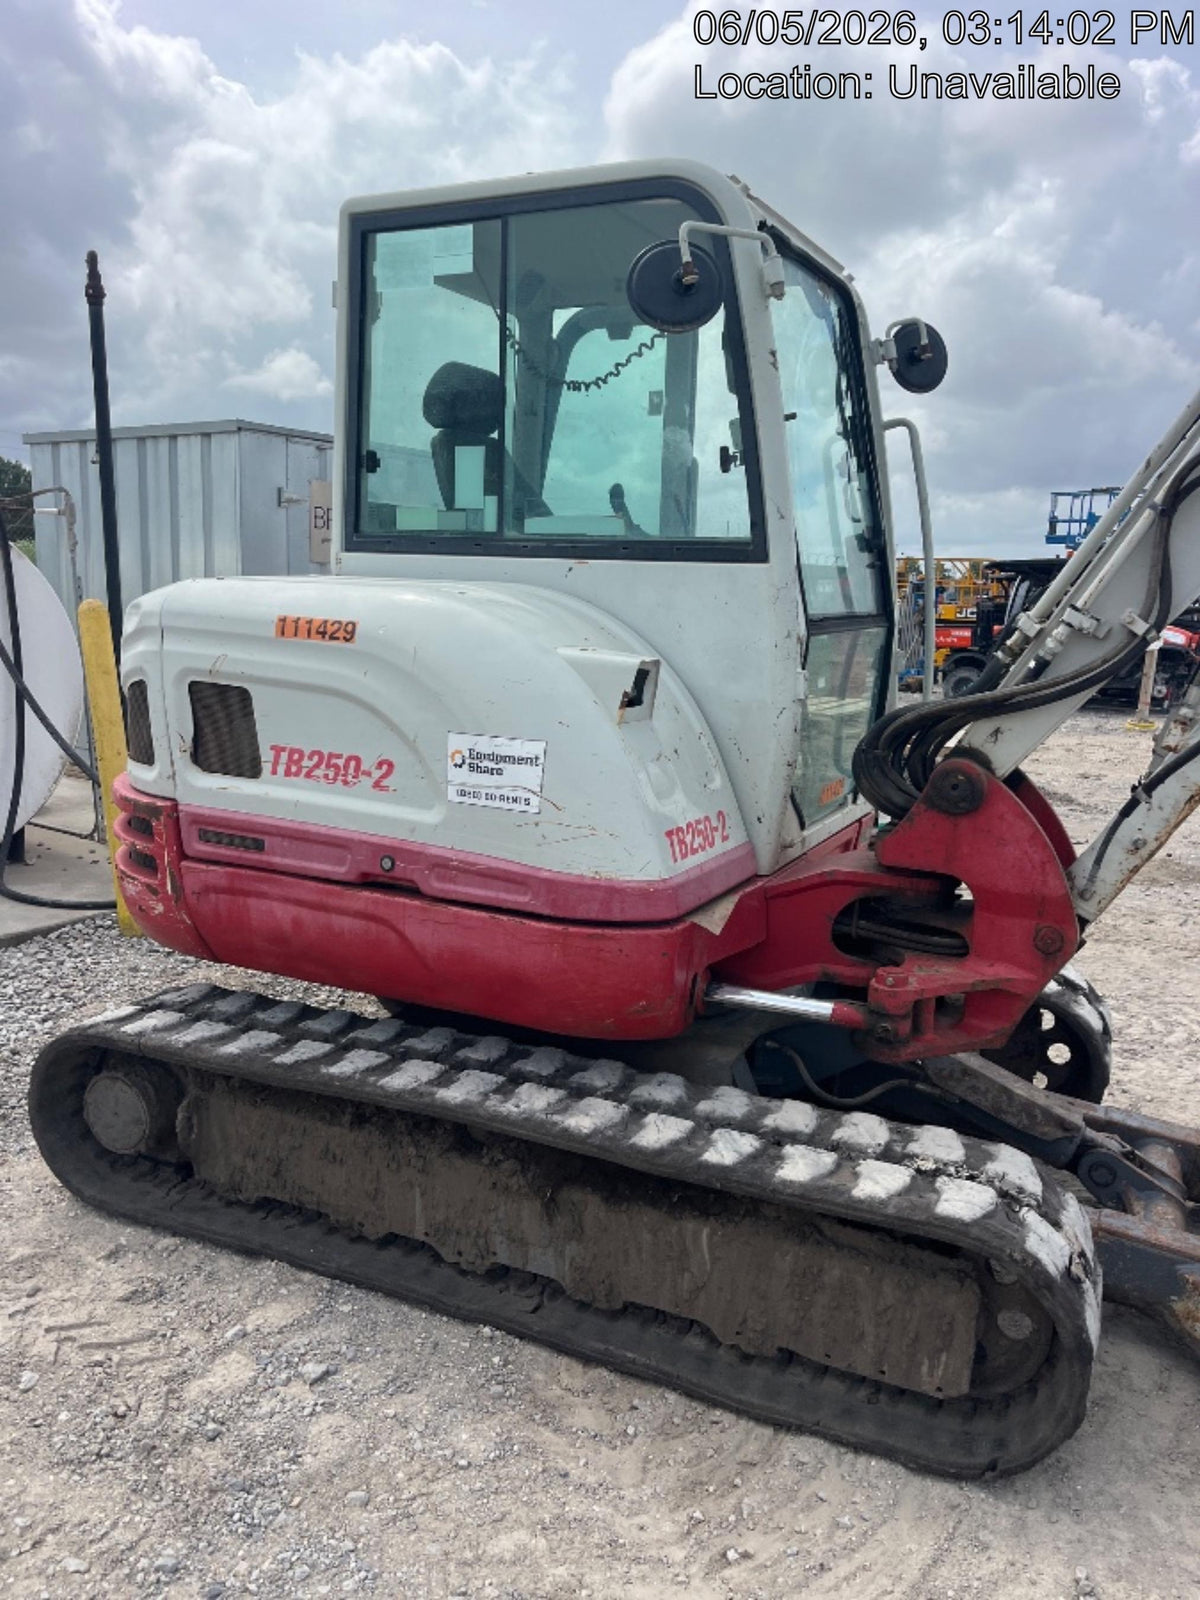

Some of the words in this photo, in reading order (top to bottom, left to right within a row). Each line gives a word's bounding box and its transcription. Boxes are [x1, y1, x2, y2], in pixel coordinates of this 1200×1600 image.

[278, 616, 356, 642] 111429
[269, 744, 395, 791] TB250-2
[468, 762, 504, 776] Share
[664, 810, 729, 864] TB250-2
